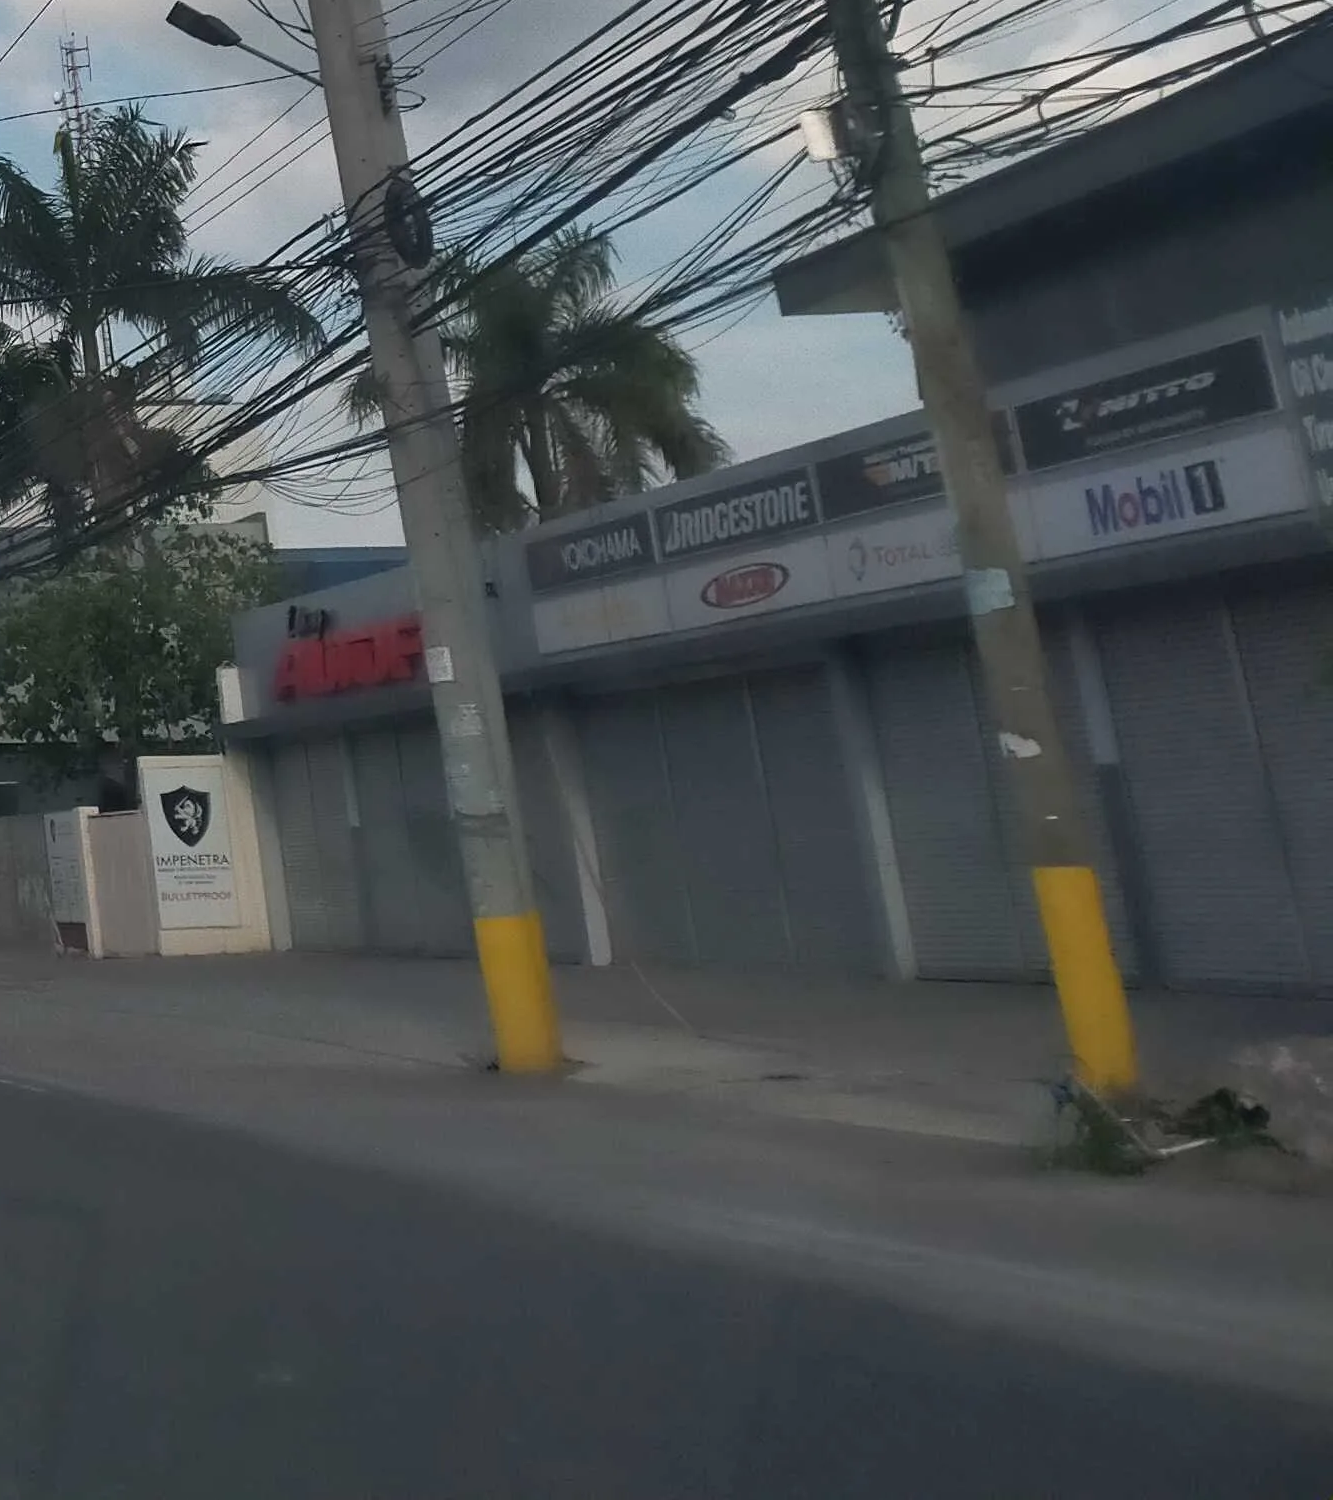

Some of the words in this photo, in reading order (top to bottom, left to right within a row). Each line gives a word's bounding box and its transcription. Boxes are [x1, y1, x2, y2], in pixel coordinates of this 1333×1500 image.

[664, 479, 810, 553] BRIDGESTONE
[1086, 466, 1184, 536] Mobil
[560, 528, 642, 572] YOKOHAMA
[872, 542, 933, 567] TOTAL
[156, 853, 230, 867] IMPENETRA
